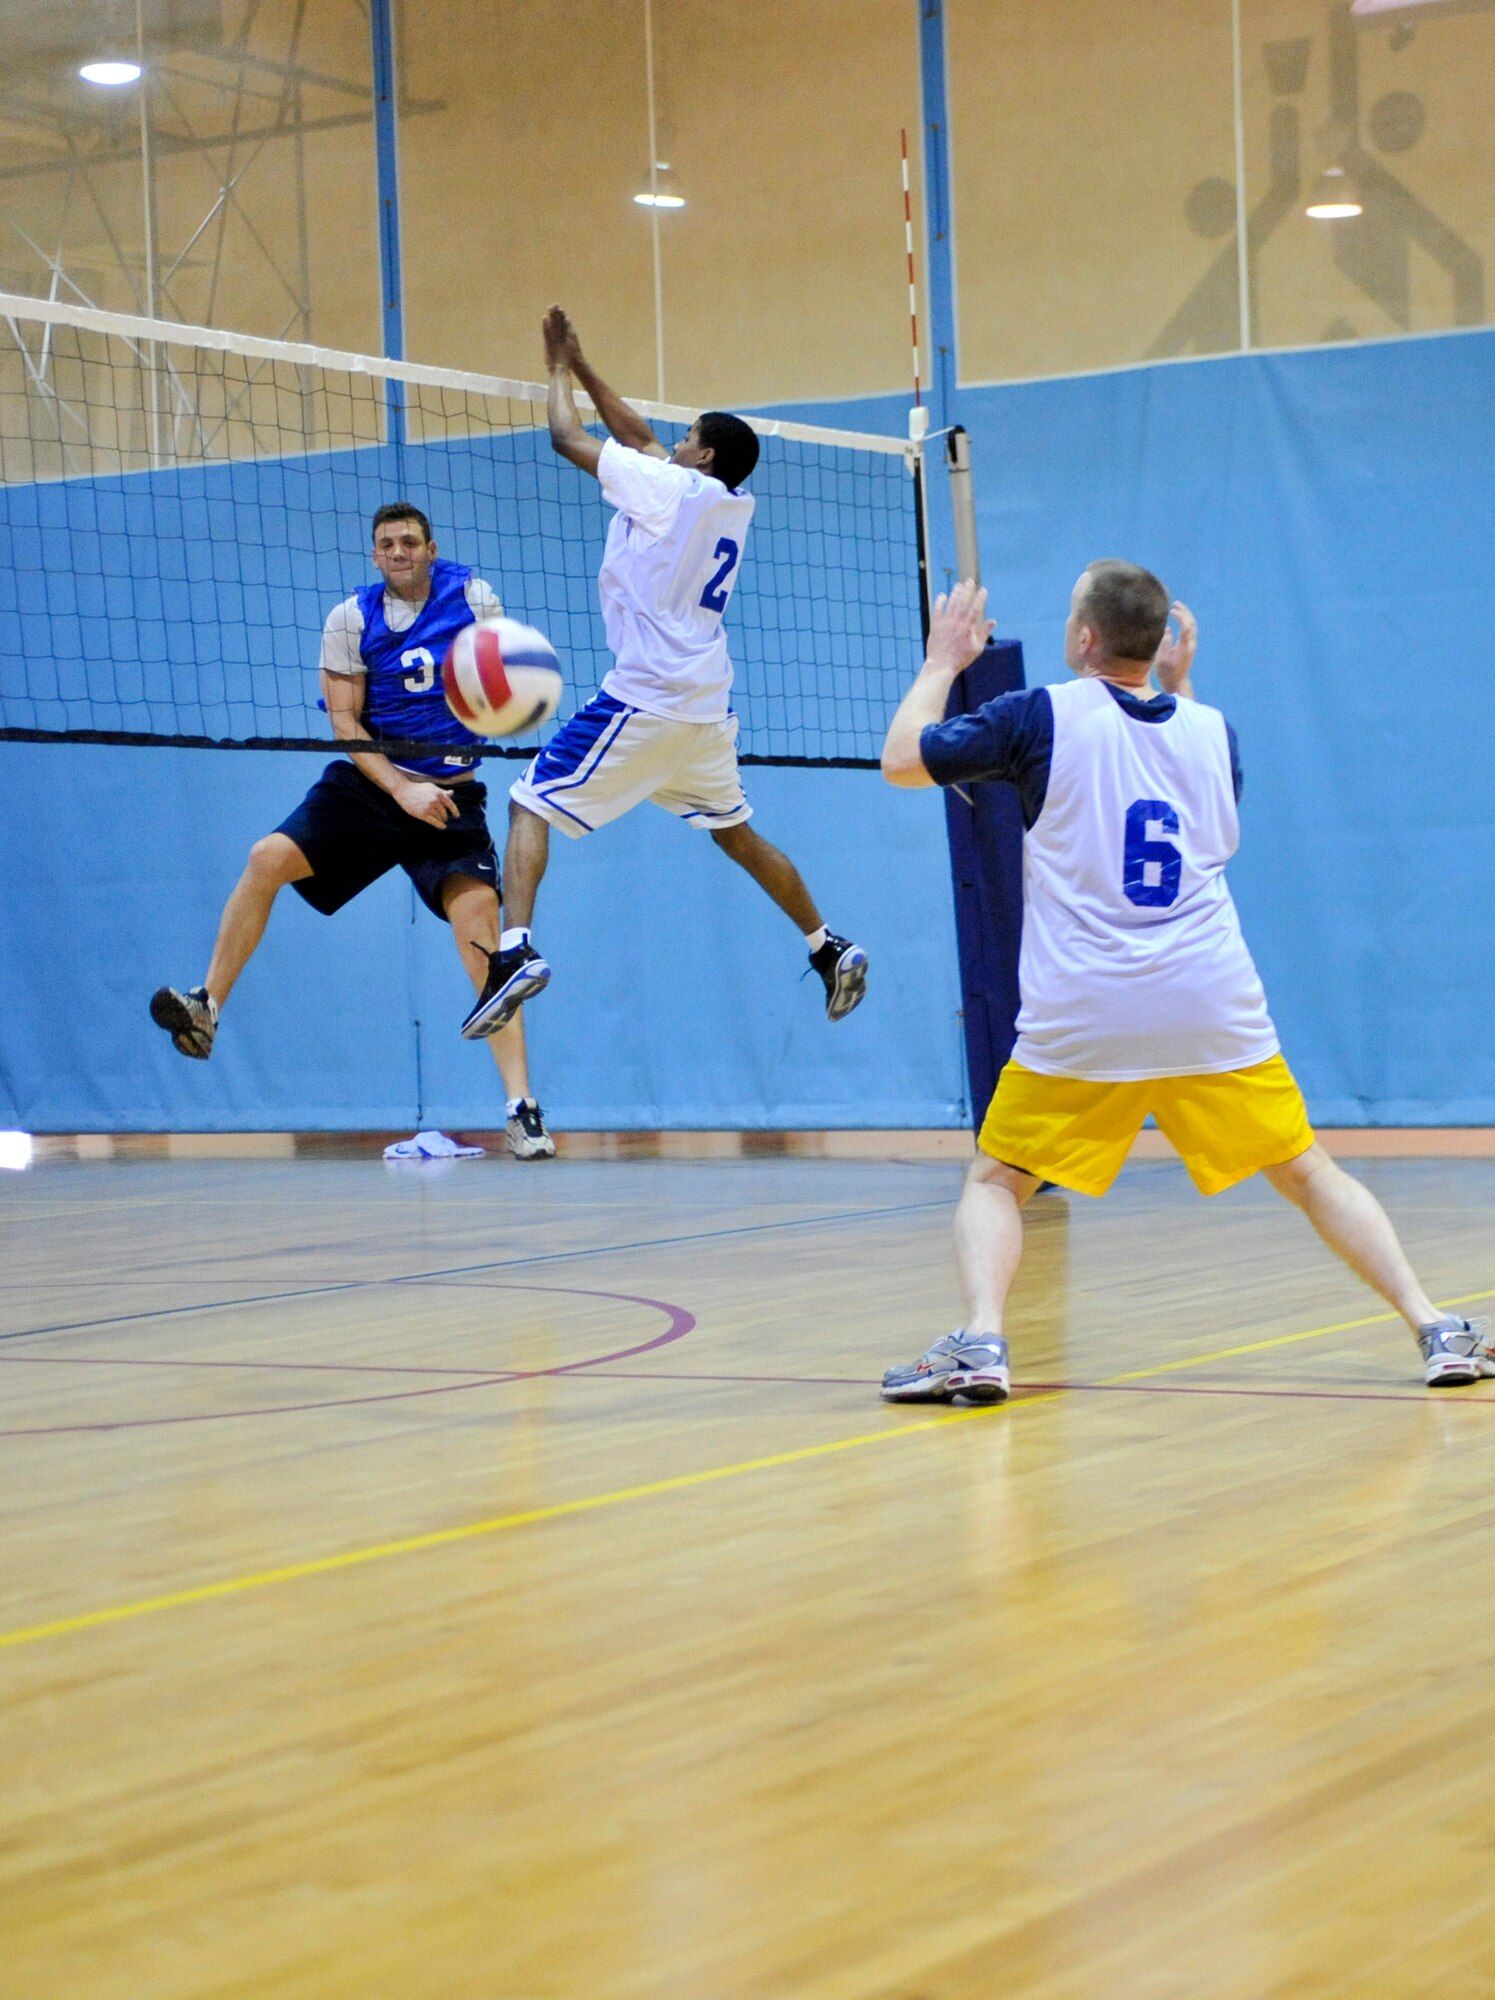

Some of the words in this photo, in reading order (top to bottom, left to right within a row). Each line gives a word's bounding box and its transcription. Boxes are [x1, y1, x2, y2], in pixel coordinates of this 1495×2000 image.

[699, 536, 739, 613] 2
[400, 646, 435, 693] 3
[1123, 799, 1182, 907] 6
